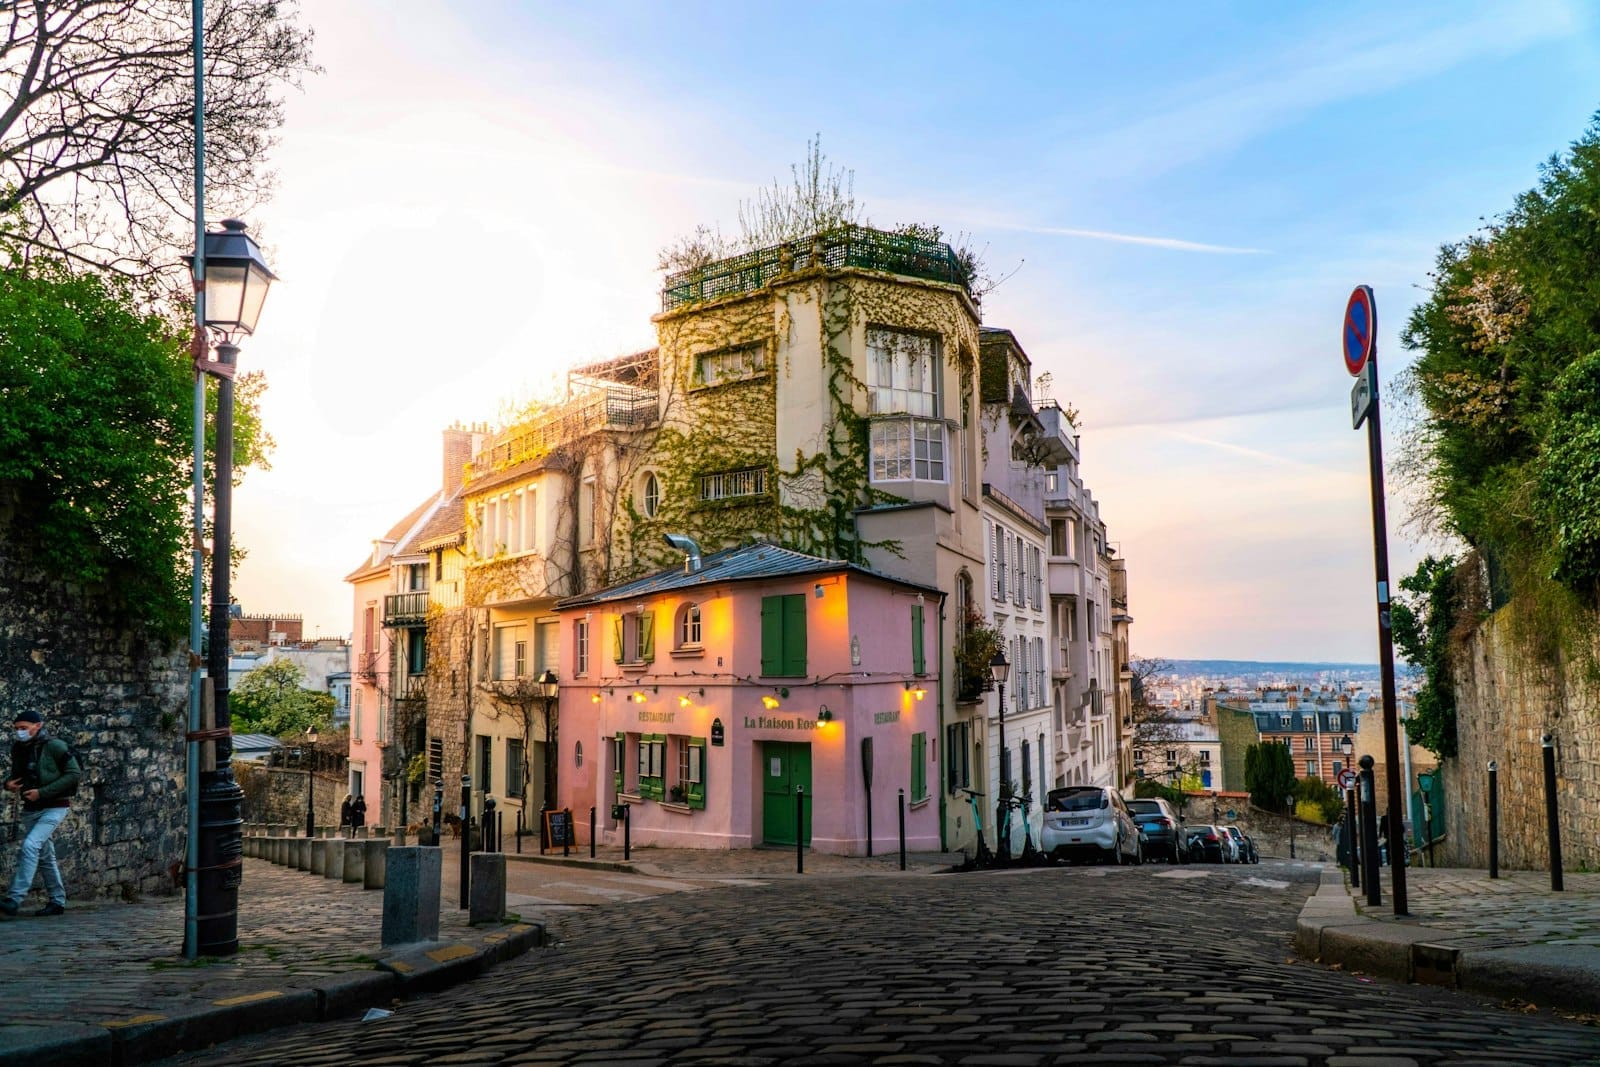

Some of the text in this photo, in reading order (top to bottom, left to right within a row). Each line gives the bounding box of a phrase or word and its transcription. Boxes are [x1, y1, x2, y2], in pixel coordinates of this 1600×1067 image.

[638, 711, 675, 724] RESTAURANT
[744, 716, 756, 729] La
[759, 716, 794, 730] Maison
